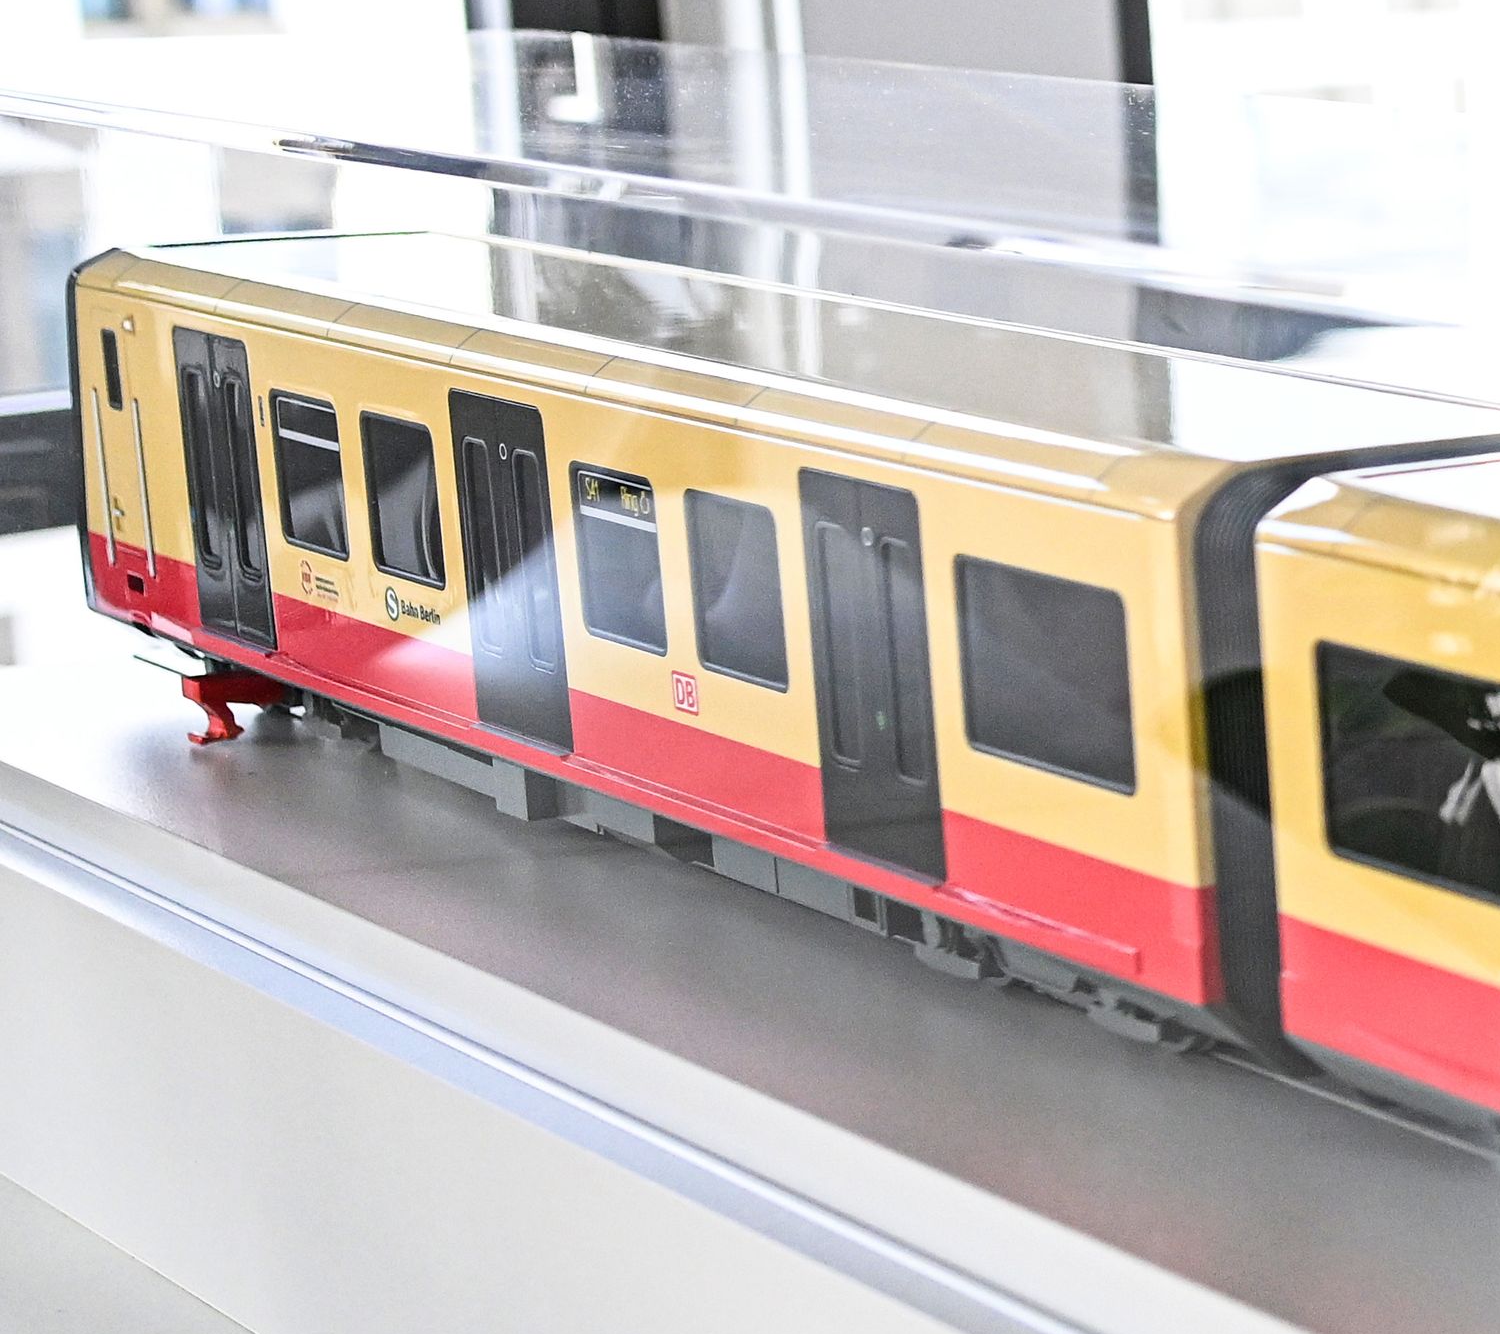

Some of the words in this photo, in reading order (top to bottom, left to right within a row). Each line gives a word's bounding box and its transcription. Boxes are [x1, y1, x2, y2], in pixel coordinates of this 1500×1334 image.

[386, 588, 399, 620] S
[400, 599, 419, 618] Bahn
[419, 605, 441, 625] Berlin
[675, 677, 695, 708] DB
